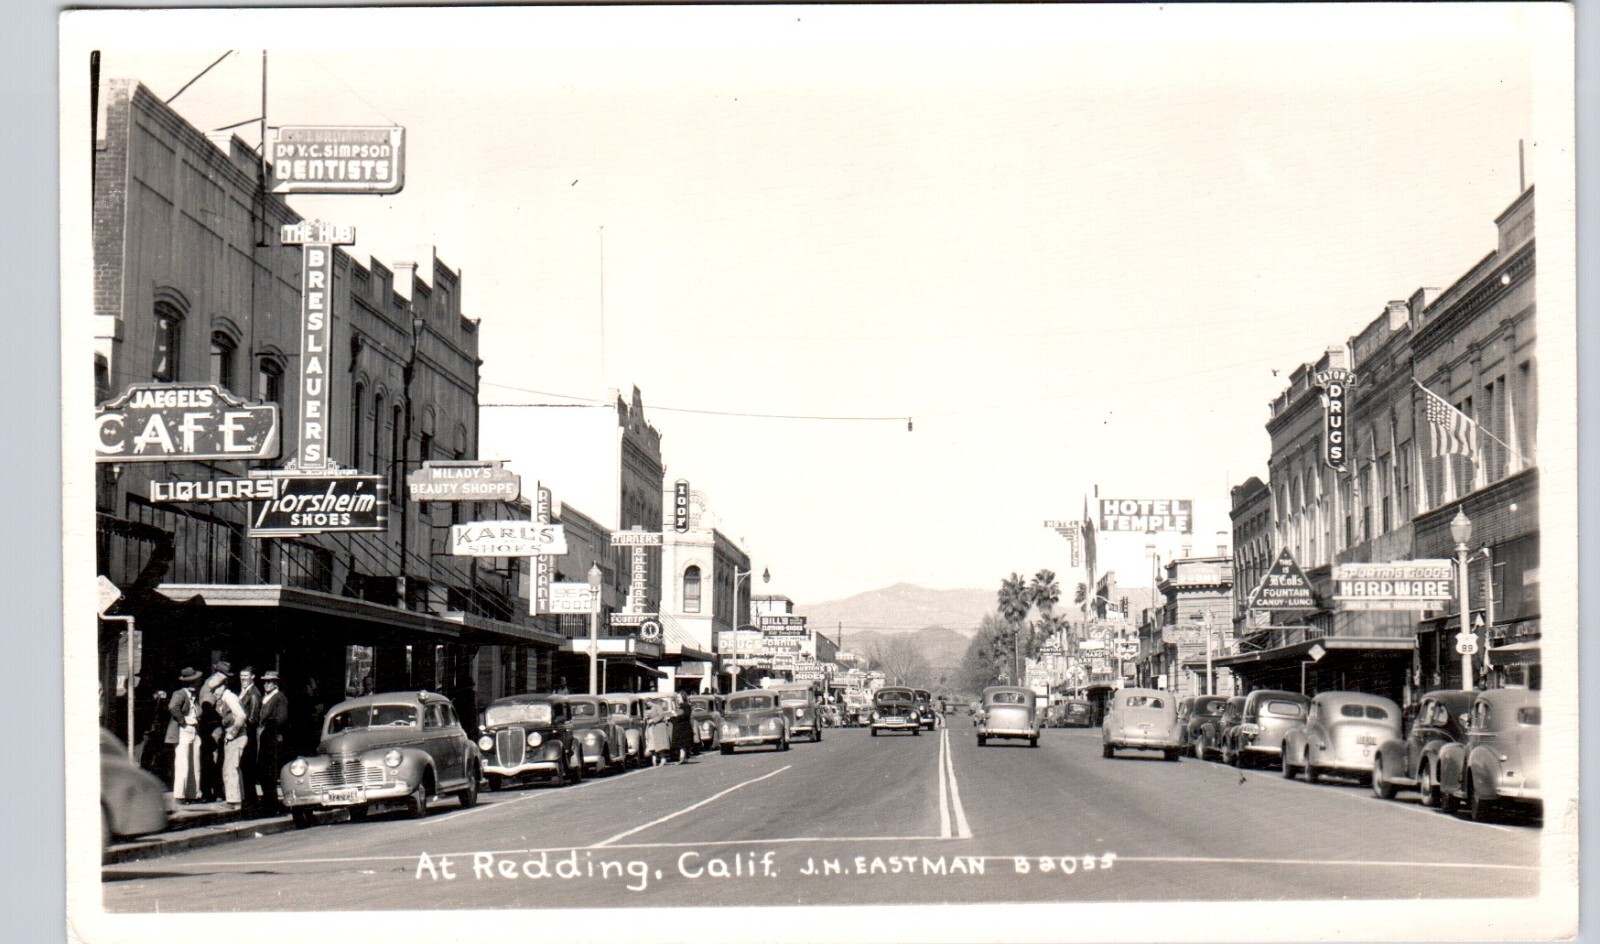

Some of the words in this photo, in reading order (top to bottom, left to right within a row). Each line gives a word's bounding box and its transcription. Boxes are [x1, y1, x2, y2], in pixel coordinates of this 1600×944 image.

[276, 160, 389, 180] DENTISTS
[283, 225, 313, 242] THE
[319, 224, 352, 242] HUB
[305, 249, 325, 462] BRESLAUERS
[1317, 371, 1354, 384] EATON'S
[130, 389, 213, 408] JAEGEL'S
[1330, 385, 1342, 459] DRUGS
[95, 412, 256, 453] CAFE
[432, 468, 491, 479] MILADY'S
[155, 480, 274, 500] LIQUORS
[410, 483, 459, 493] BEAUTY
[462, 483, 514, 493] SHOPPE
[1104, 500, 1188, 515] HOTEL
[291, 513, 351, 526] SHOES
[1104, 516, 1187, 531] TEMPLE
[456, 527, 555, 545] KARL'S
[468, 544, 541, 554] SHOES
[1341, 567, 1404, 579] SPORTING
[1408, 567, 1450, 579] GOODS
[1263, 589, 1310, 597] FOUNTAIN
[1341, 581, 1450, 596] HARDWARE
[1461, 644, 1473, 653] 99
